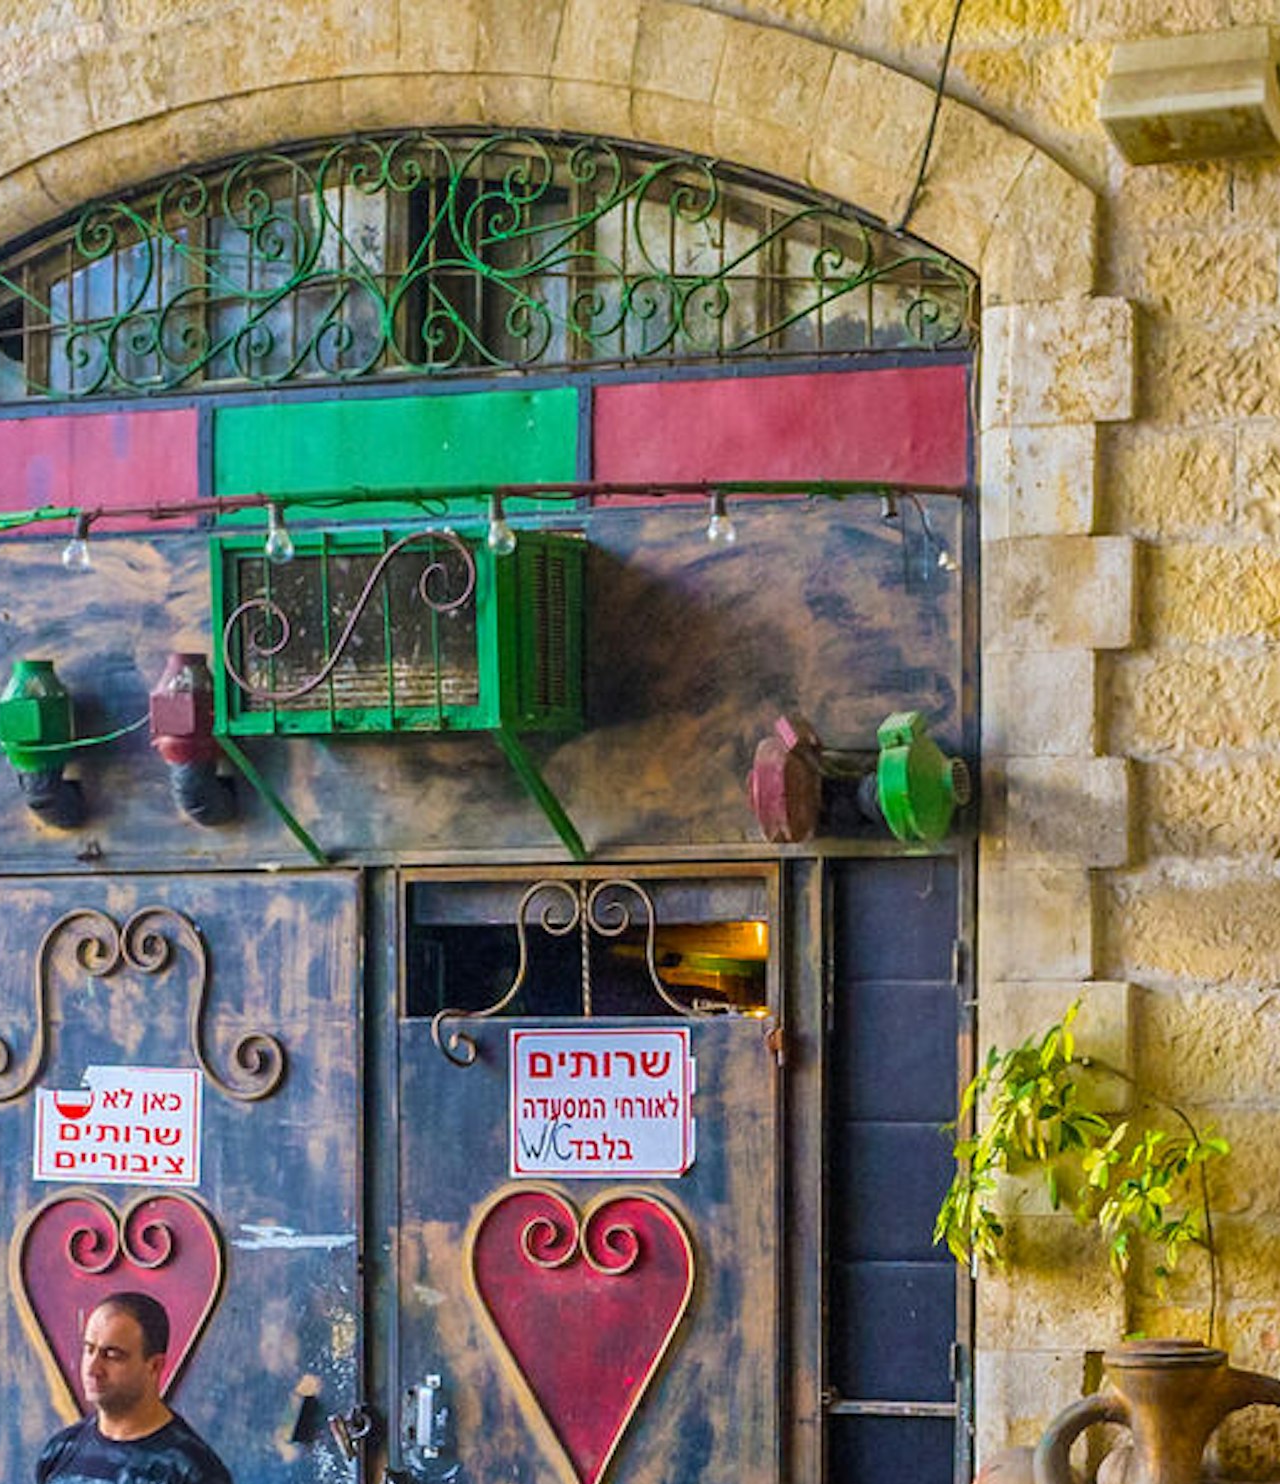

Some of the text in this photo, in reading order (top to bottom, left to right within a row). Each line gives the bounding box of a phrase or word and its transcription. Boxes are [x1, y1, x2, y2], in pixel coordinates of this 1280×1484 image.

[529, 1051, 670, 1078] שרותים
[102, 1088, 183, 1115] כאן לא
[523, 1089, 680, 1121] לאורחי המסעדה
[58, 1123, 182, 1146] שרותים
[569, 1133, 634, 1160] בלבד
[55, 1152, 185, 1175] ציבוריים
